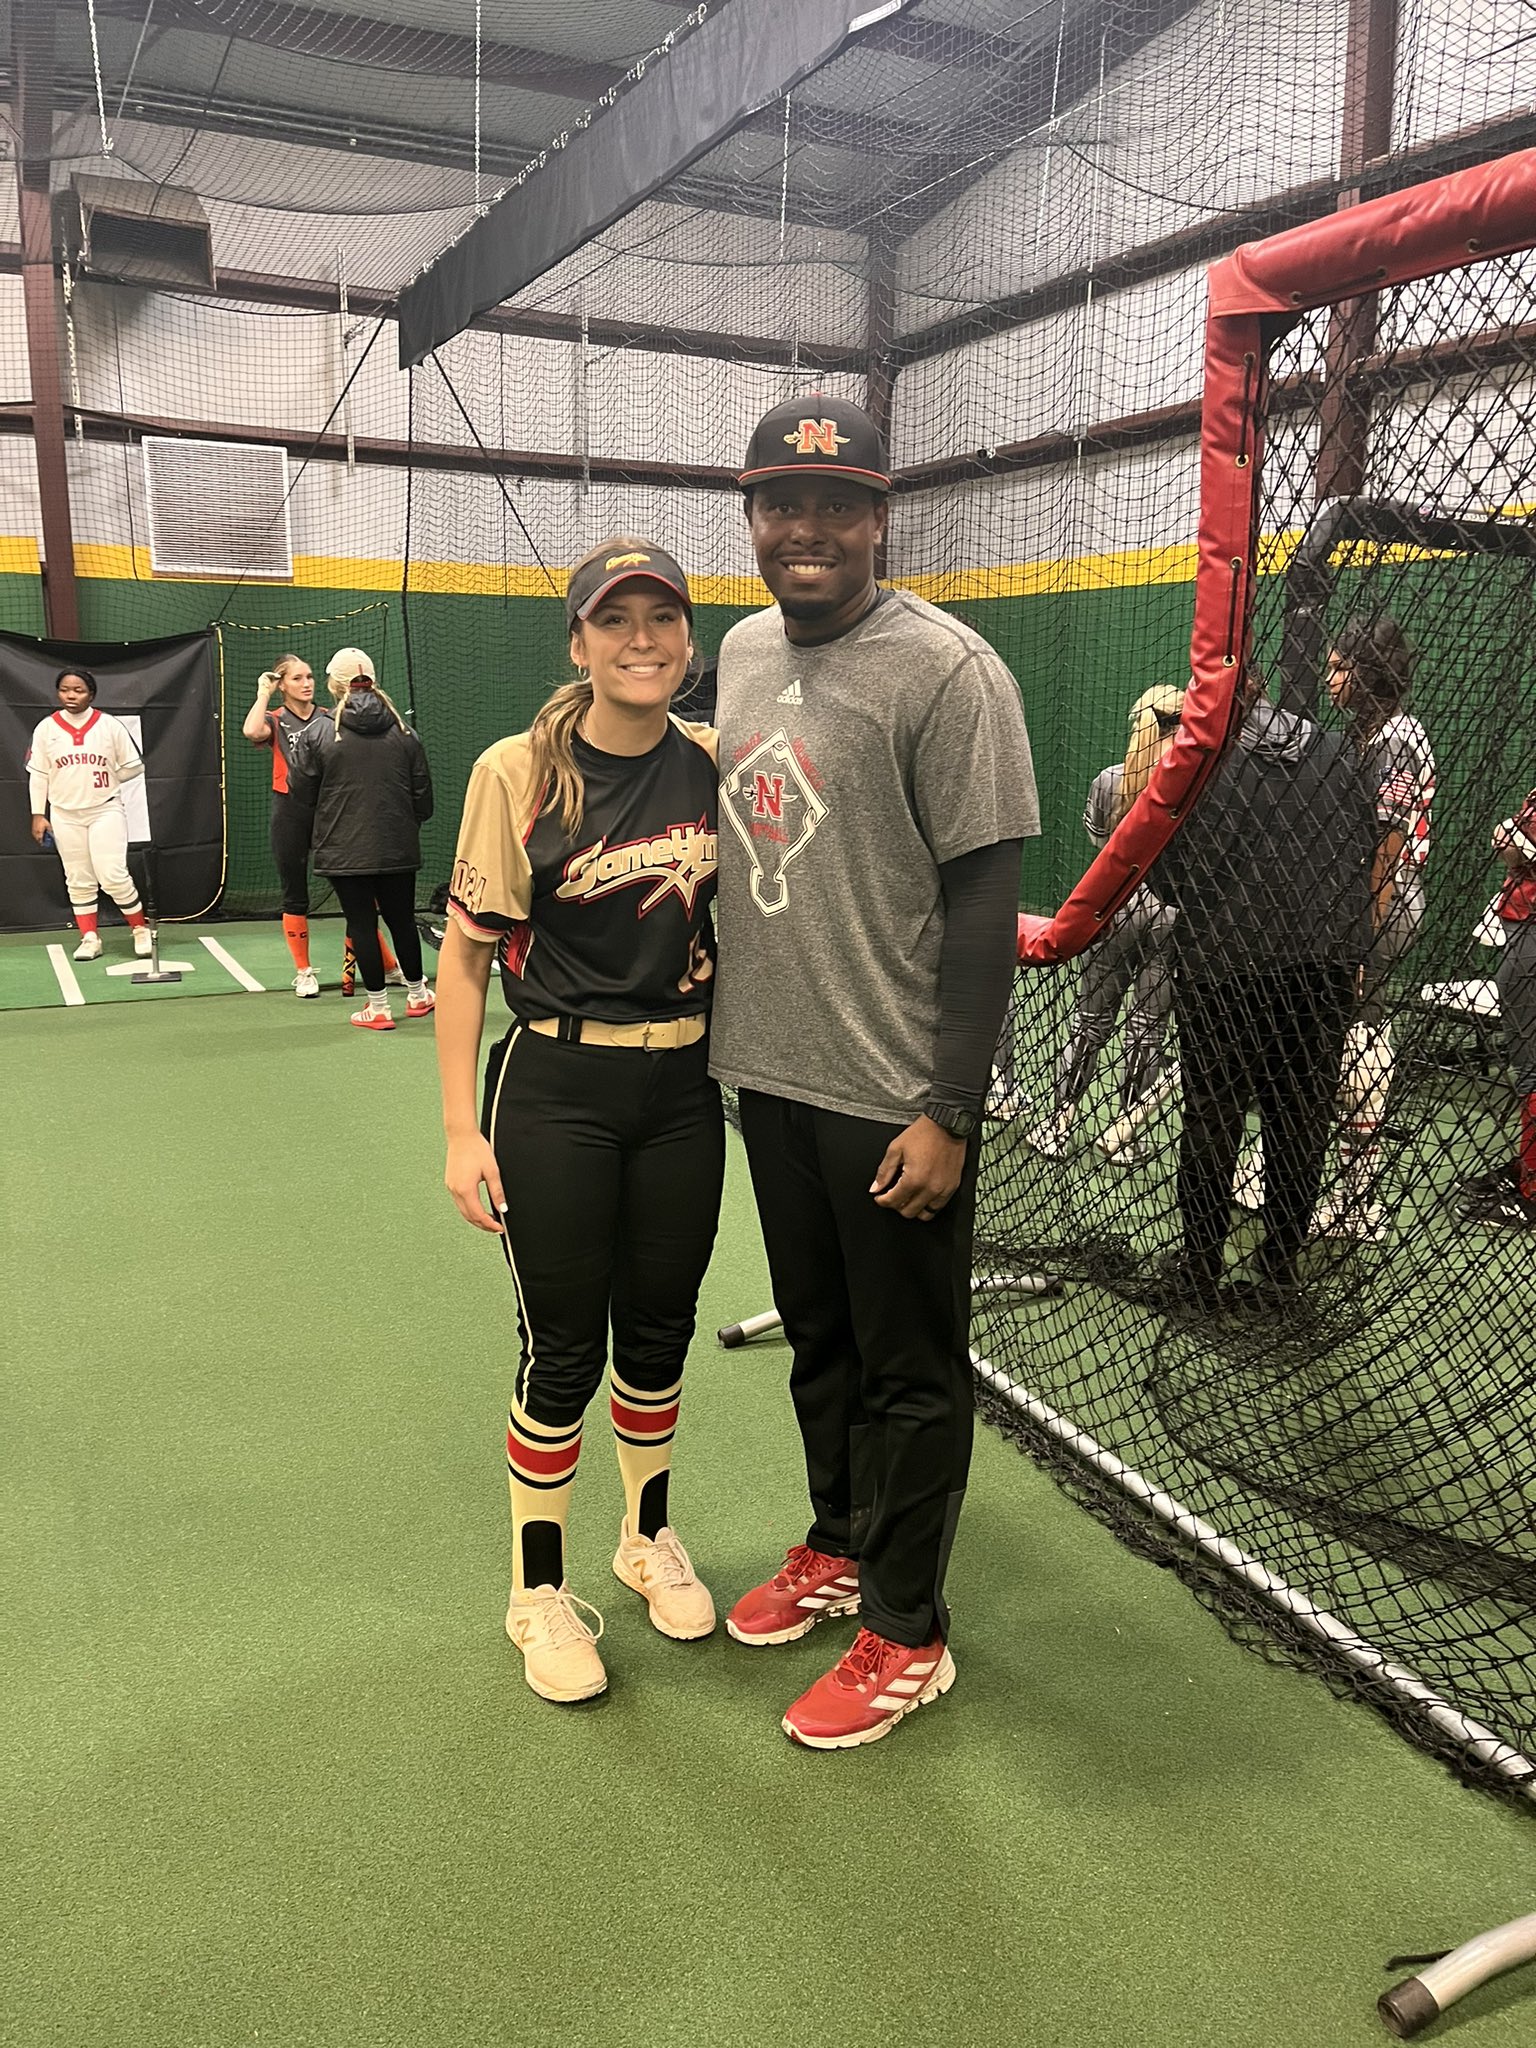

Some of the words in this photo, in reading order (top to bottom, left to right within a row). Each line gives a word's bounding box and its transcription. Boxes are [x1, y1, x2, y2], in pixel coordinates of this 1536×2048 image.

[796, 418, 838, 456] N
[93, 771, 109, 788] 30
[752, 770, 785, 821] N
